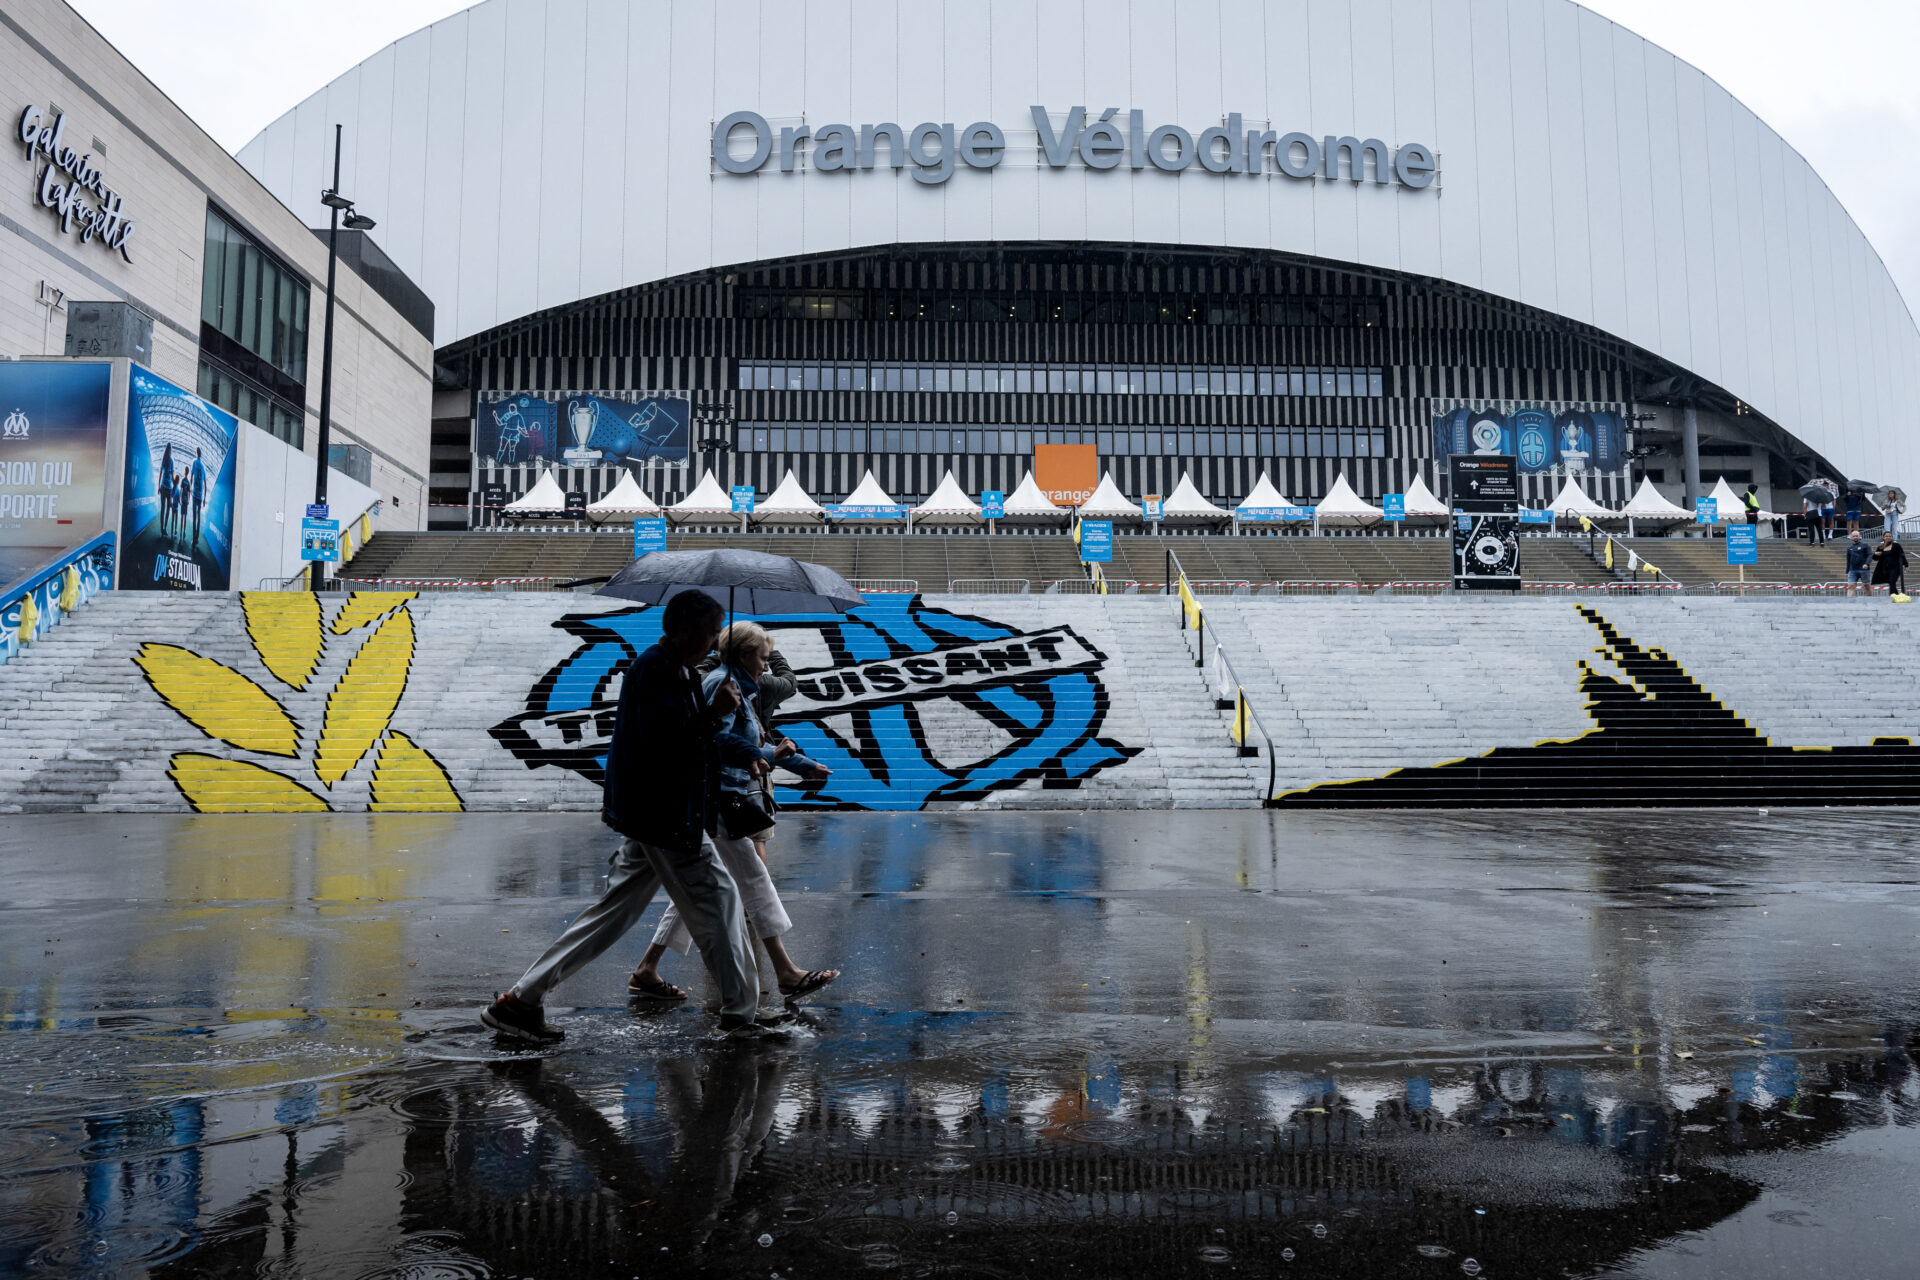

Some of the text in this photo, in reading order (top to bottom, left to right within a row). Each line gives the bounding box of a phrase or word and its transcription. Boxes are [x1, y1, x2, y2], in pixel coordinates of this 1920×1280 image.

[18, 104, 106, 200] Galeries
[713, 105, 1435, 189] Orange Vélodrome
[38, 163, 141, 265] Lafayette
[41, 461, 73, 489] QUI
[168, 557, 202, 592] STADIUM
[776, 636, 1065, 701] UISSANT
